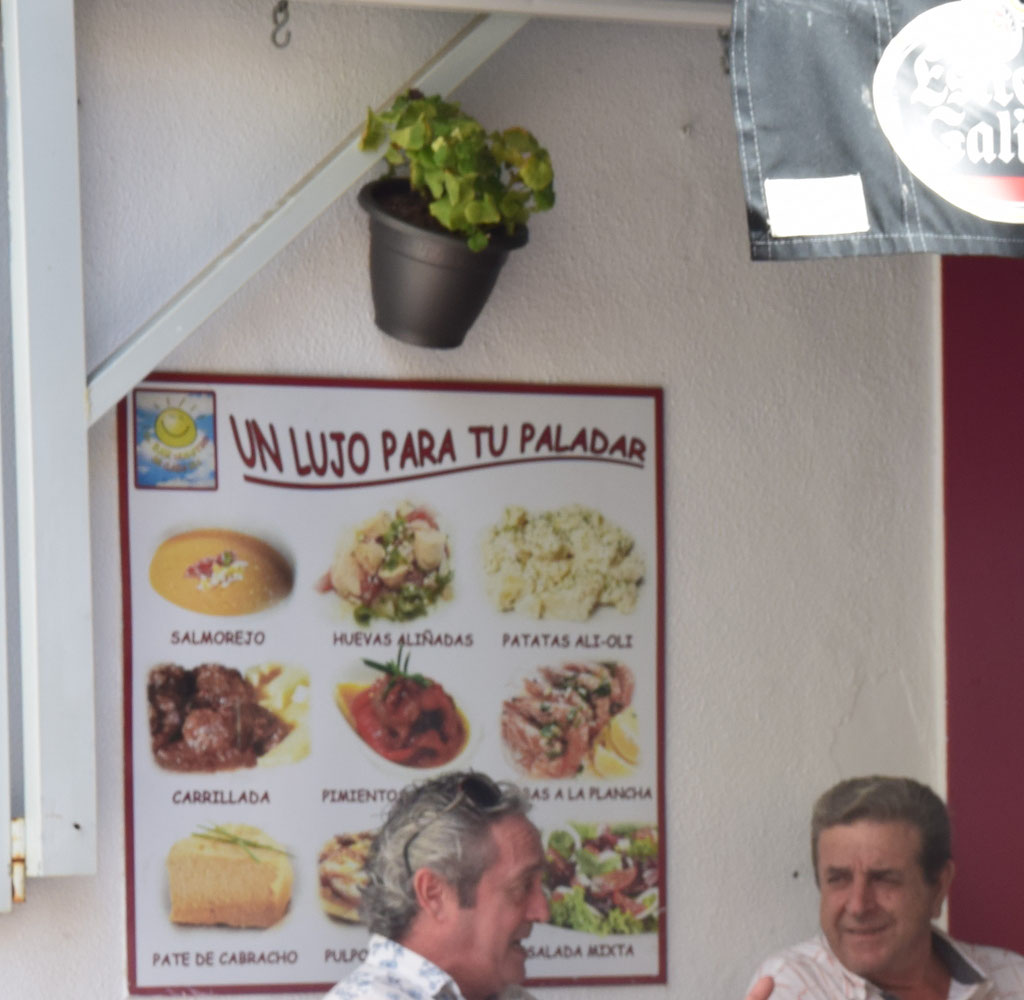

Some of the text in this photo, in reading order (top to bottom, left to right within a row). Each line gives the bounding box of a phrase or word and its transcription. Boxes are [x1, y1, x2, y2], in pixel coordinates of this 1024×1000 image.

[229, 414, 284, 474] UN
[289, 426, 371, 478] LUJO
[381, 429, 457, 473] PARA
[468, 424, 509, 459] TU
[520, 422, 647, 462] PALADAR
[170, 630, 267, 646] SALMOREJO
[332, 628, 474, 648] HUEVAS ALIÑADAS
[502, 632, 634, 649] PATATAS ALI-OLI
[171, 789, 272, 805] CARRILLADA
[321, 787, 403, 803] PIMIENTO
[554, 787, 565, 801] A
[567, 786, 584, 800] LA
[588, 786, 654, 800] PLANCHA
[152, 950, 299, 967] PATE DE CABRACHO
[324, 948, 369, 963] PULPO
[525, 943, 635, 960] SALADA MIXTA
